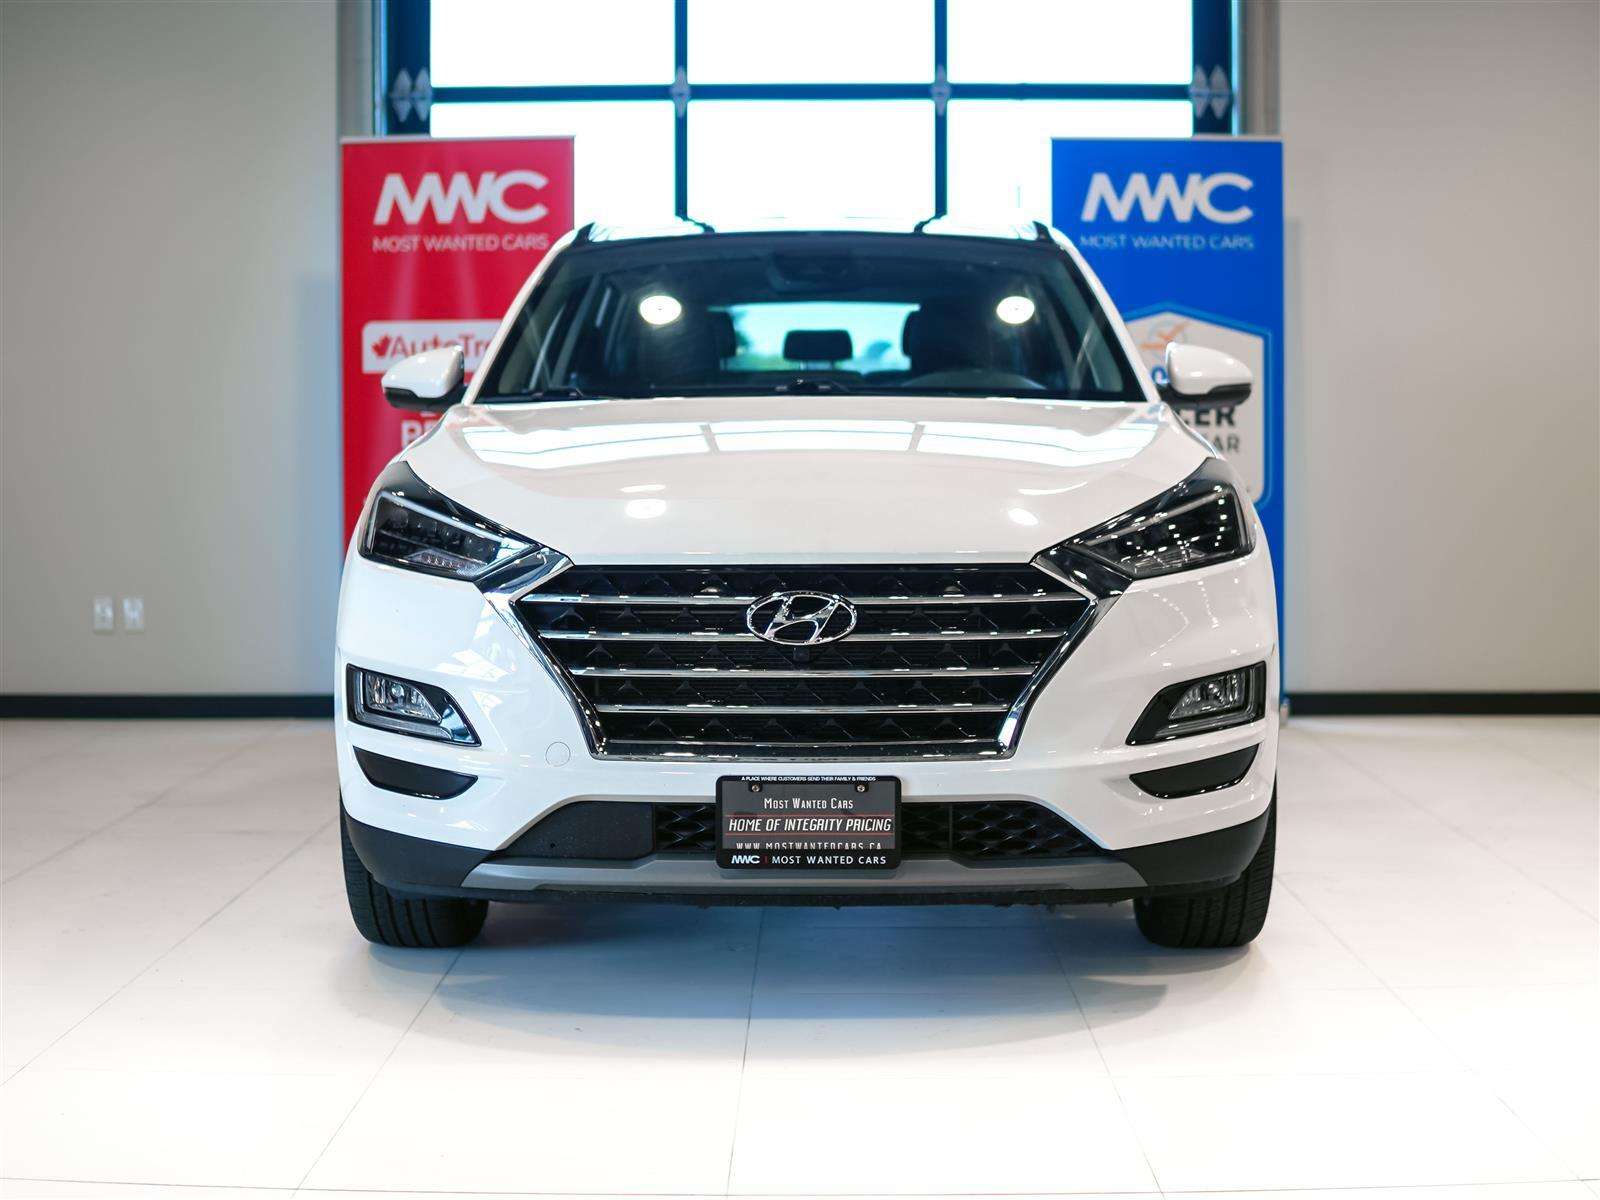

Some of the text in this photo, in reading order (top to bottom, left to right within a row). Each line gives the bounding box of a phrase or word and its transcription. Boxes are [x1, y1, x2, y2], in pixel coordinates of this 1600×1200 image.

[373, 169, 550, 226] MWC
[1080, 171, 1254, 224] MWC
[372, 232, 549, 252] MOST WANTED CARS
[1080, 233, 1254, 249] MOST WANTED CARS
[728, 818, 892, 832] HOME OF INTEGRITY PRICING
[731, 854, 886, 865] MWC MOST WANTED CARS
